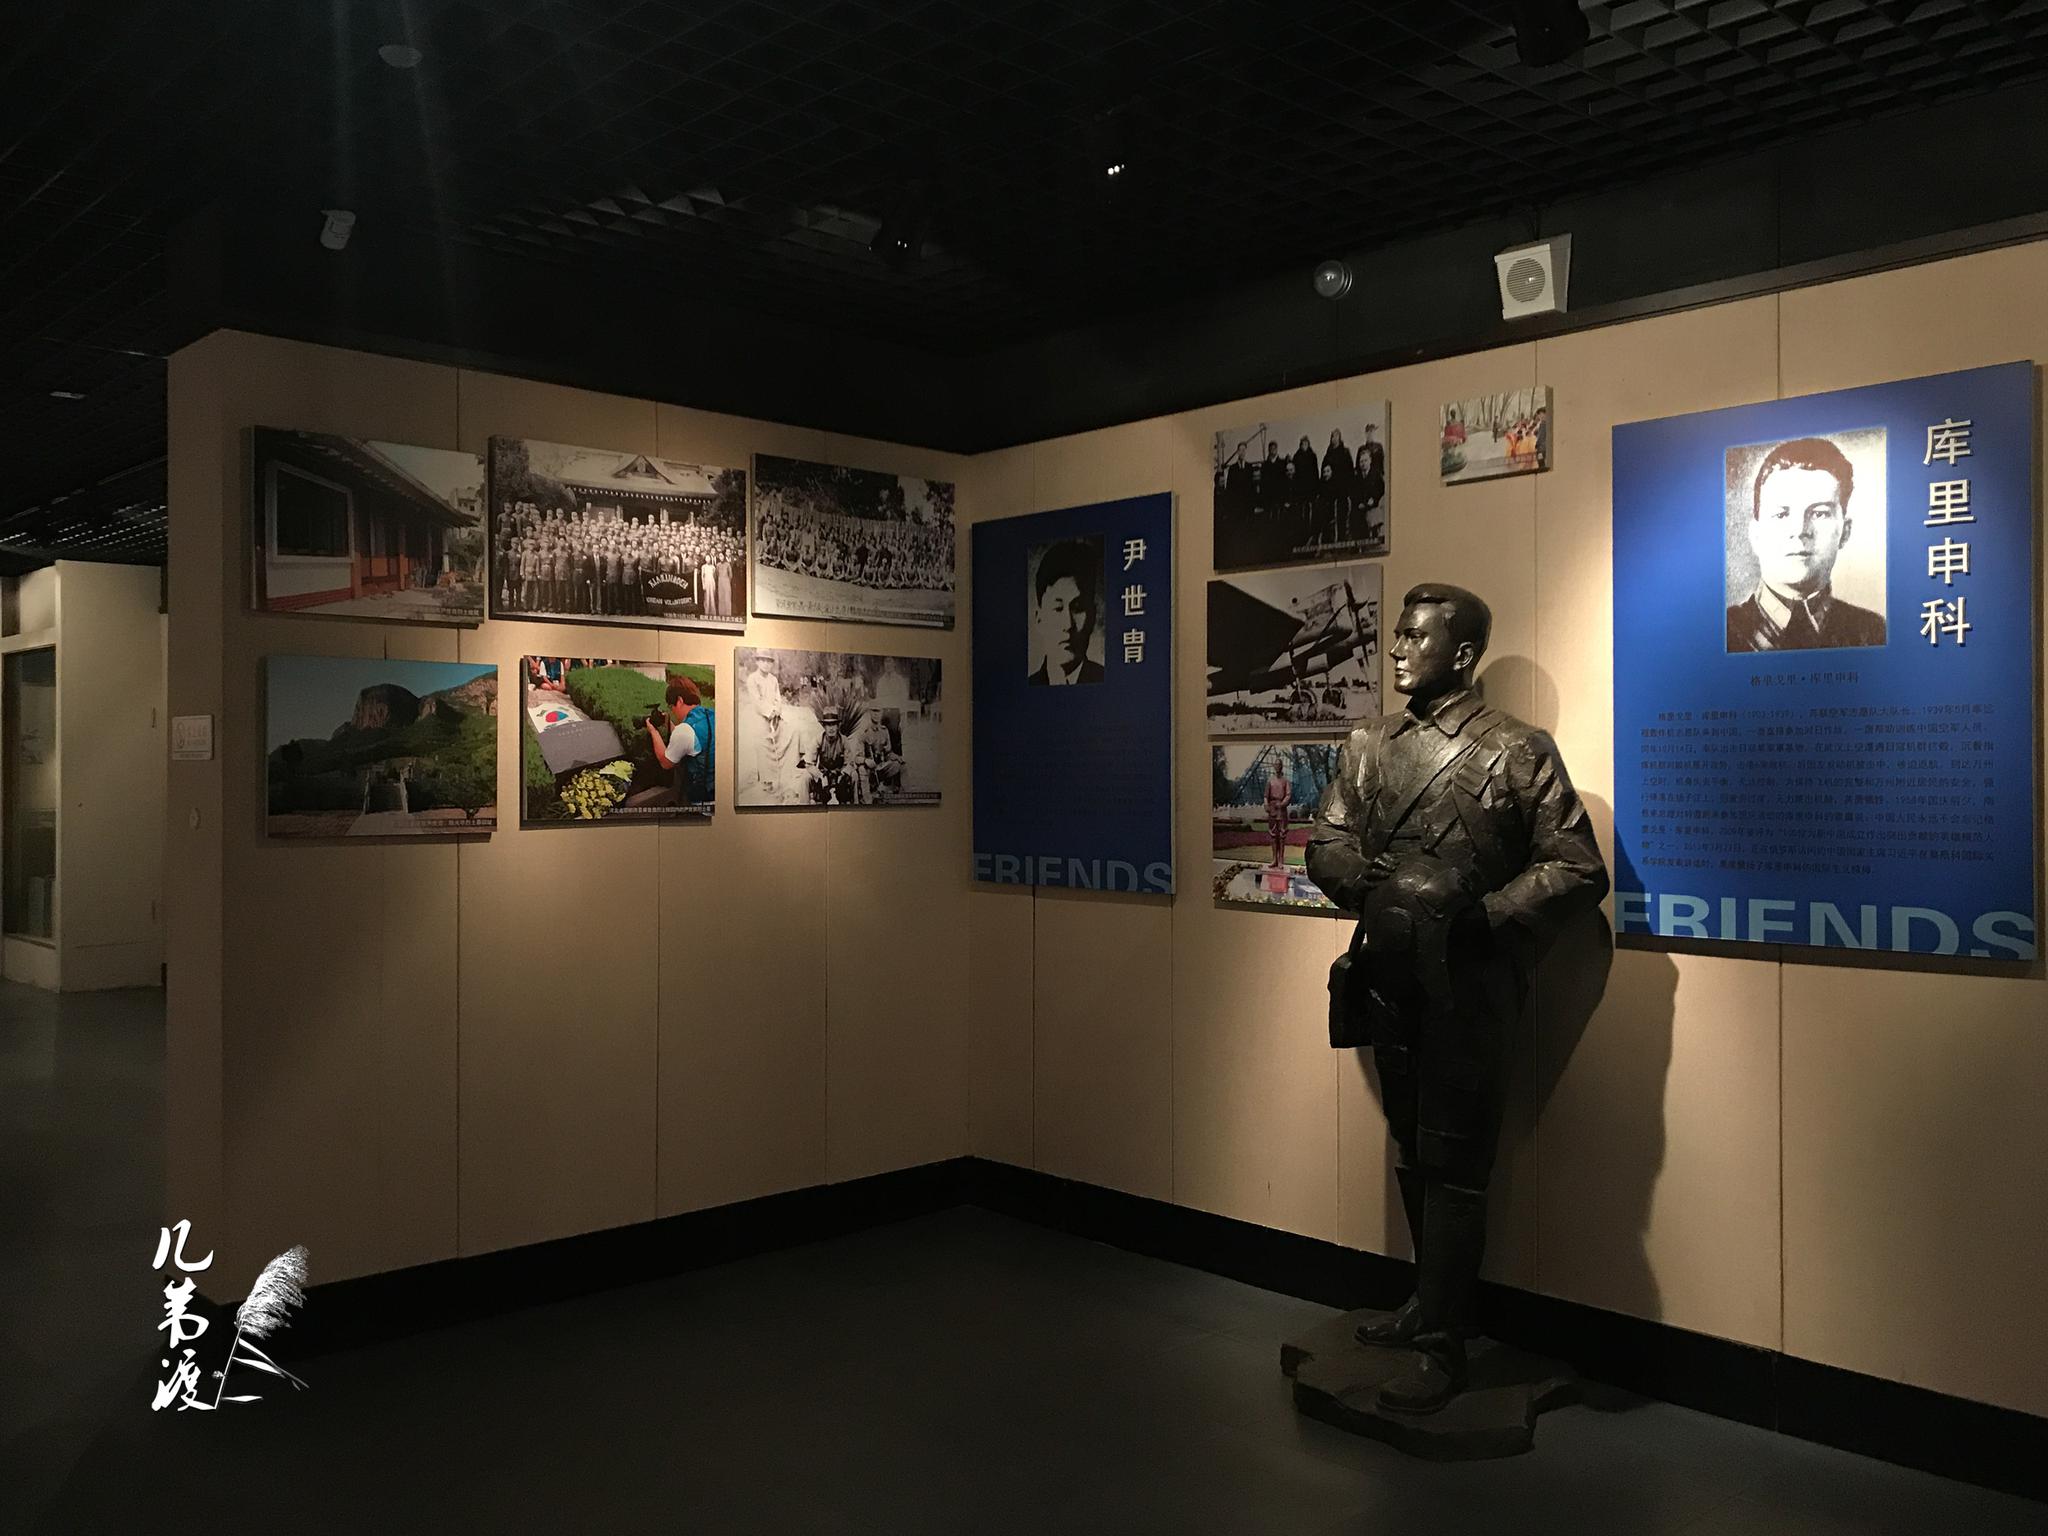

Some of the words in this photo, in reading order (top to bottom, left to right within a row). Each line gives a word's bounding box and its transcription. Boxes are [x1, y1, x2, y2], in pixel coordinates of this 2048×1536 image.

[1920, 418, 1976, 645] 库里申科
[973, 852, 1171, 894] FRIENDS
[1615, 891, 2035, 961] FRIENDS
